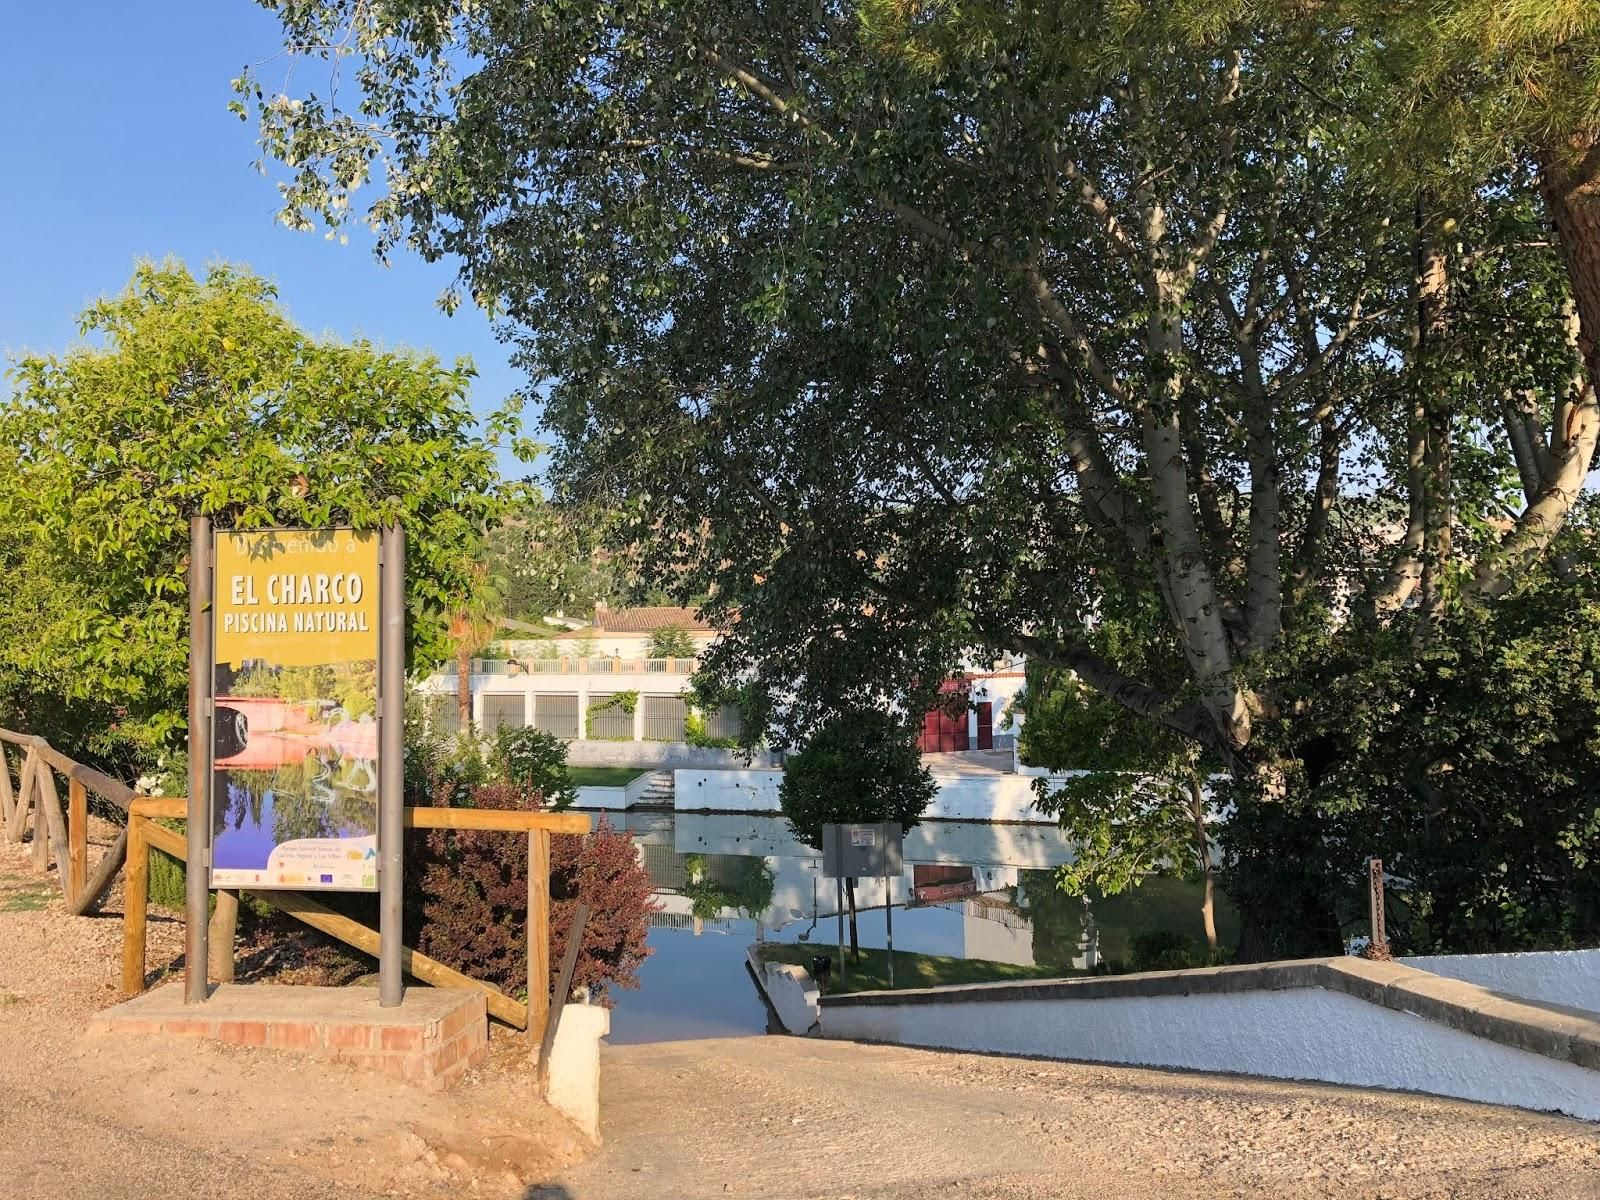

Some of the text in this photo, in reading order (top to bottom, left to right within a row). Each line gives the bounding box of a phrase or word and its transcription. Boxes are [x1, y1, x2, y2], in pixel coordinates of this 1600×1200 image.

[346, 539, 357, 553] a
[231, 573, 363, 605] EL CHARCO
[224, 611, 369, 633] PISCINA NATURAL
